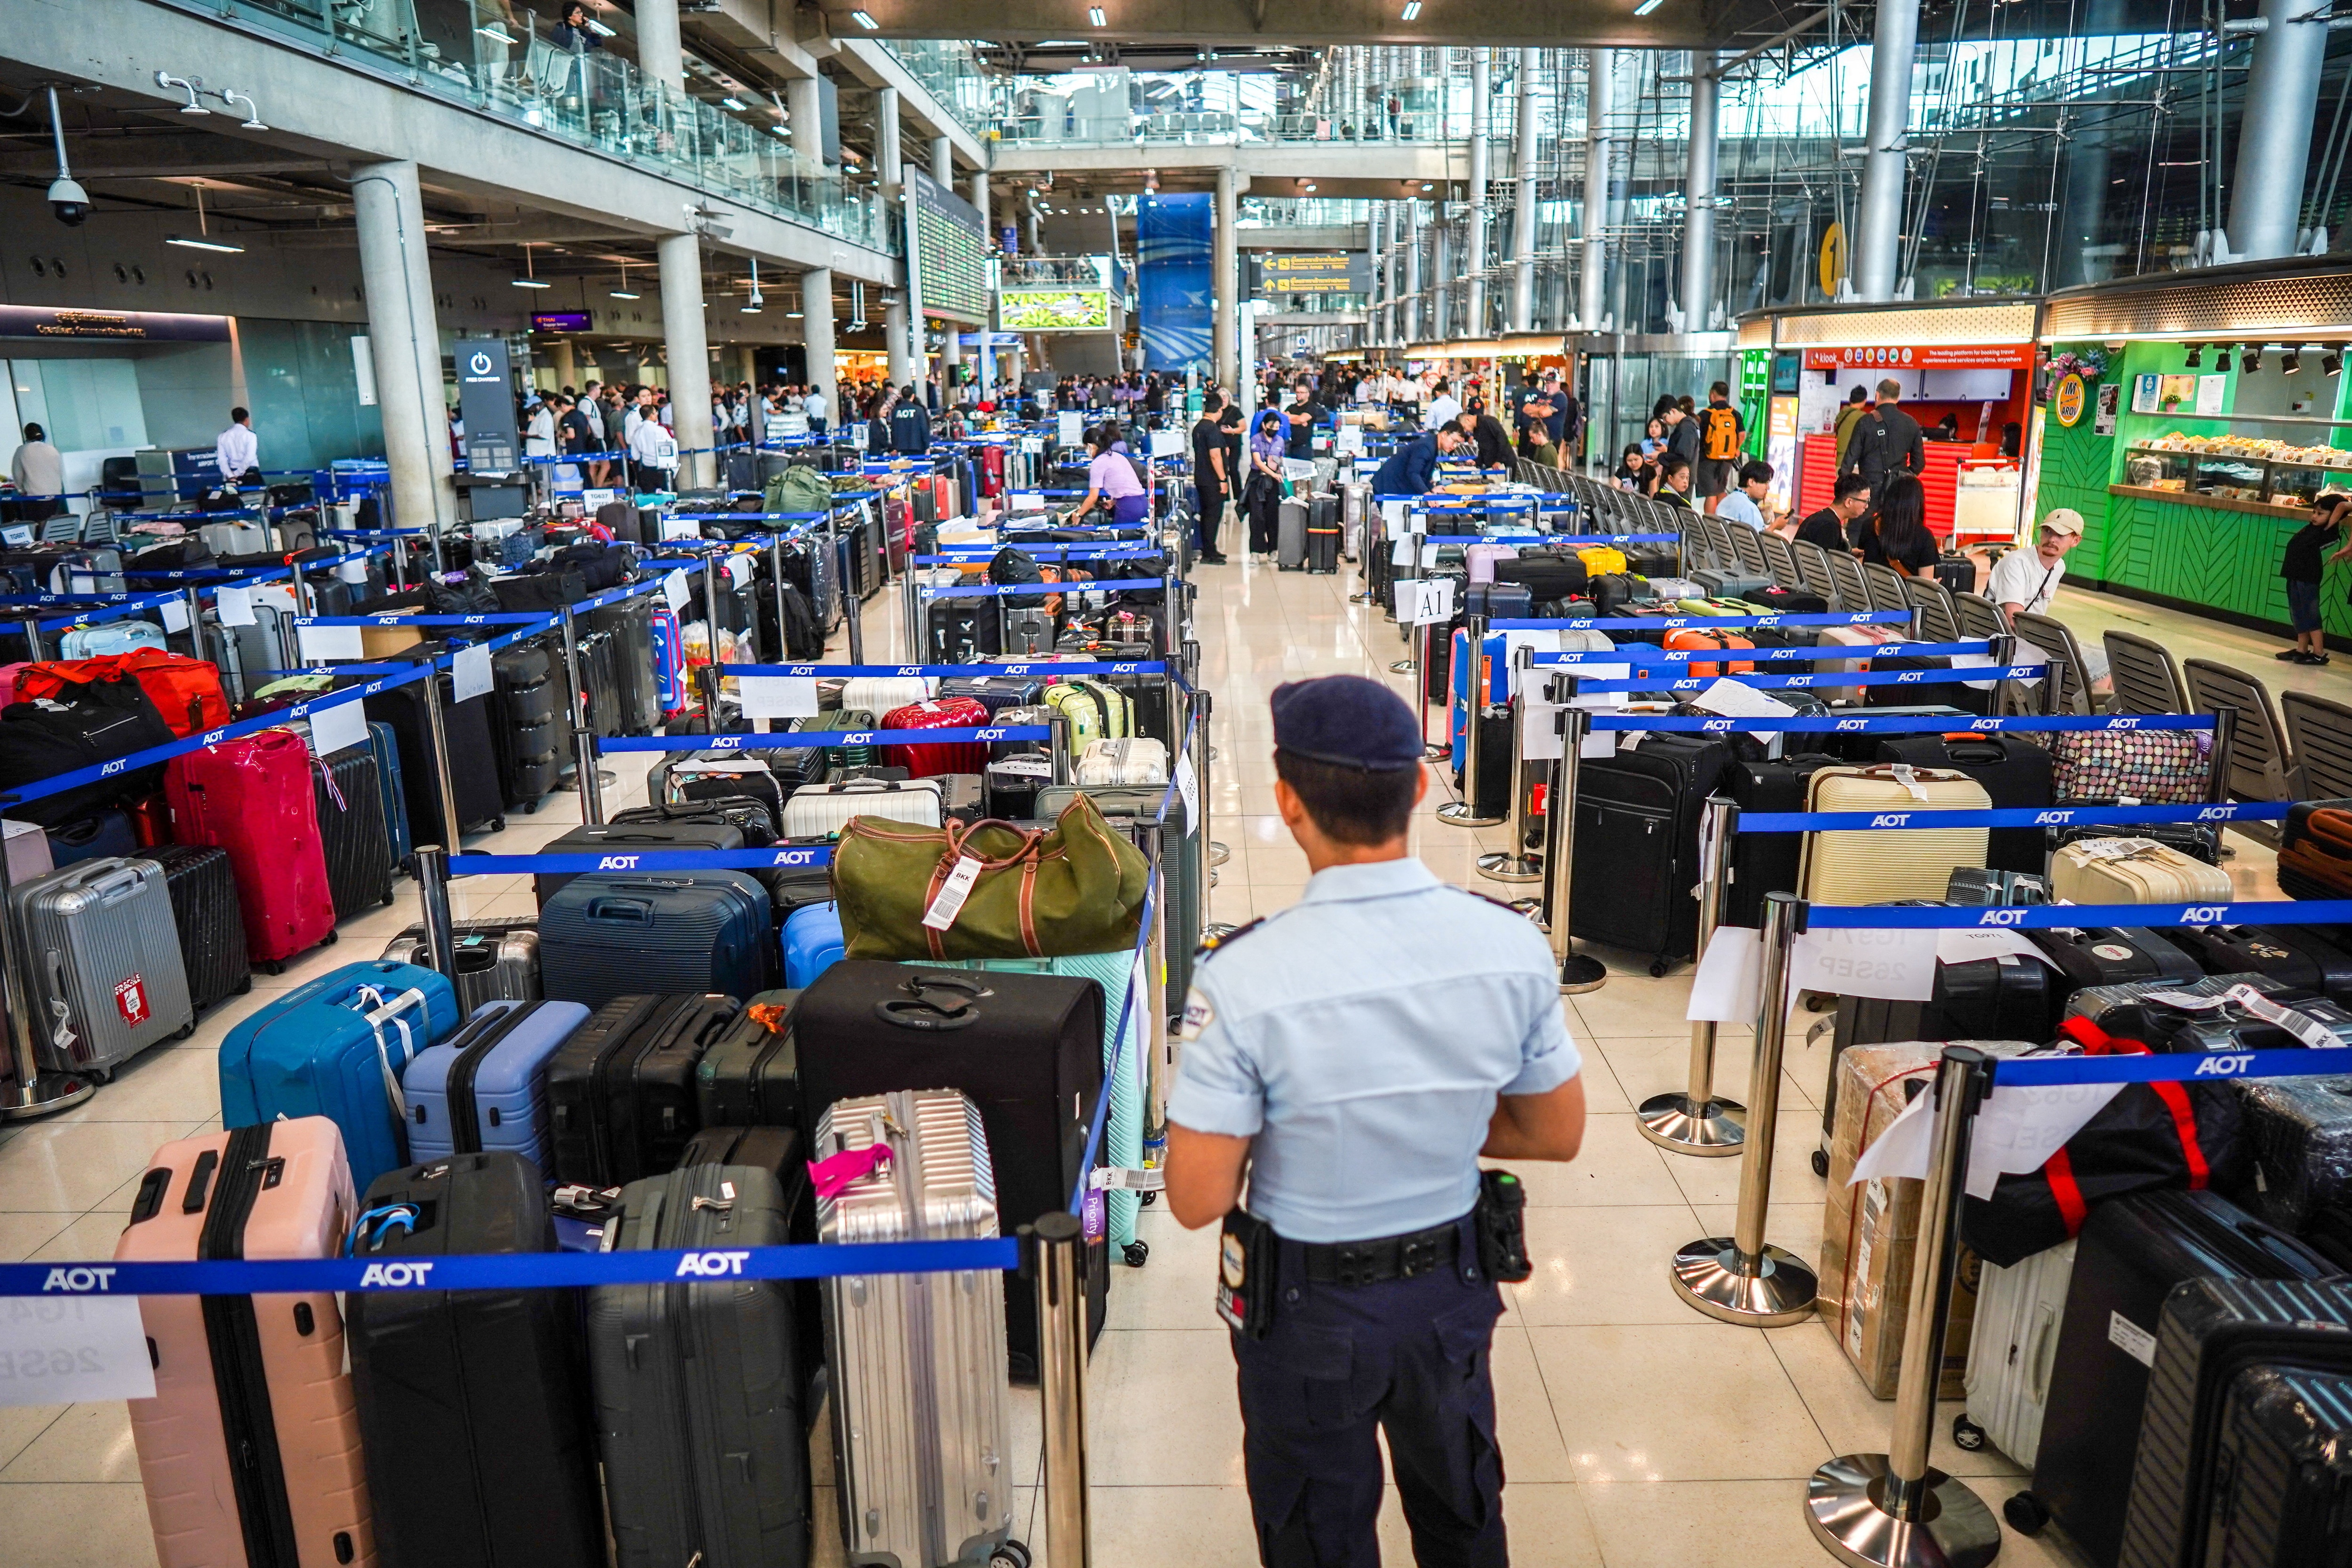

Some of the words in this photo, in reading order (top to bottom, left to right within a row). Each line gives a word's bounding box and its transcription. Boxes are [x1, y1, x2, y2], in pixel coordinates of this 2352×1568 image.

[1820, 353, 1837, 363] klook
[2065, 381, 2076, 396] IM
[896, 409, 916, 419] AOT
[1025, 442, 1039, 452] A7
[132, 602, 143, 610] AOT
[1420, 589, 1443, 618] A1
[75, 614, 88, 623] AOT
[550, 617, 558, 626] AOT
[512, 631, 522, 641] AOT
[1771, 650, 1796, 658] AOT
[1876, 647, 1901, 655] AOT
[1558, 653, 1584, 662] AOT
[790, 667, 815, 675] AOT
[1897, 672, 1924, 681] AOT
[2007, 668, 2034, 677] AOT
[1673, 679, 1700, 688] AOT
[1786, 677, 1813, 685] AOT
[366, 681, 382, 694] AOT
[290, 704, 308, 718] AOT
[1702, 720, 1735, 730] AOT
[1836, 720, 1868, 730] AOT
[1971, 719, 2003, 729] AOT
[2107, 718, 2140, 728] AOT
[203, 730, 224, 745] AOT
[842, 733, 874, 744] AOT
[975, 729, 1006, 740] AOT
[711, 737, 741, 748] AOT
[102, 759, 126, 775] AOT
[2034, 811, 2074, 823] AOT
[2197, 807, 2237, 819] AOT
[1871, 814, 1911, 827] AOT
[598, 856, 639, 869] AOT
[774, 851, 814, 864] AOT
[956, 872, 971, 882] BKK
[1979, 910, 2028, 924] AOT
[2180, 907, 2228, 922] AOT
[2315, 1033, 2328, 1048] BKK
[2194, 1055, 2255, 1075] AOT
[1087, 1197, 1099, 1234] Priority
[676, 1252, 749, 1276] AOT
[43, 1268, 116, 1290] AOT
[360, 1263, 433, 1287] AOT
